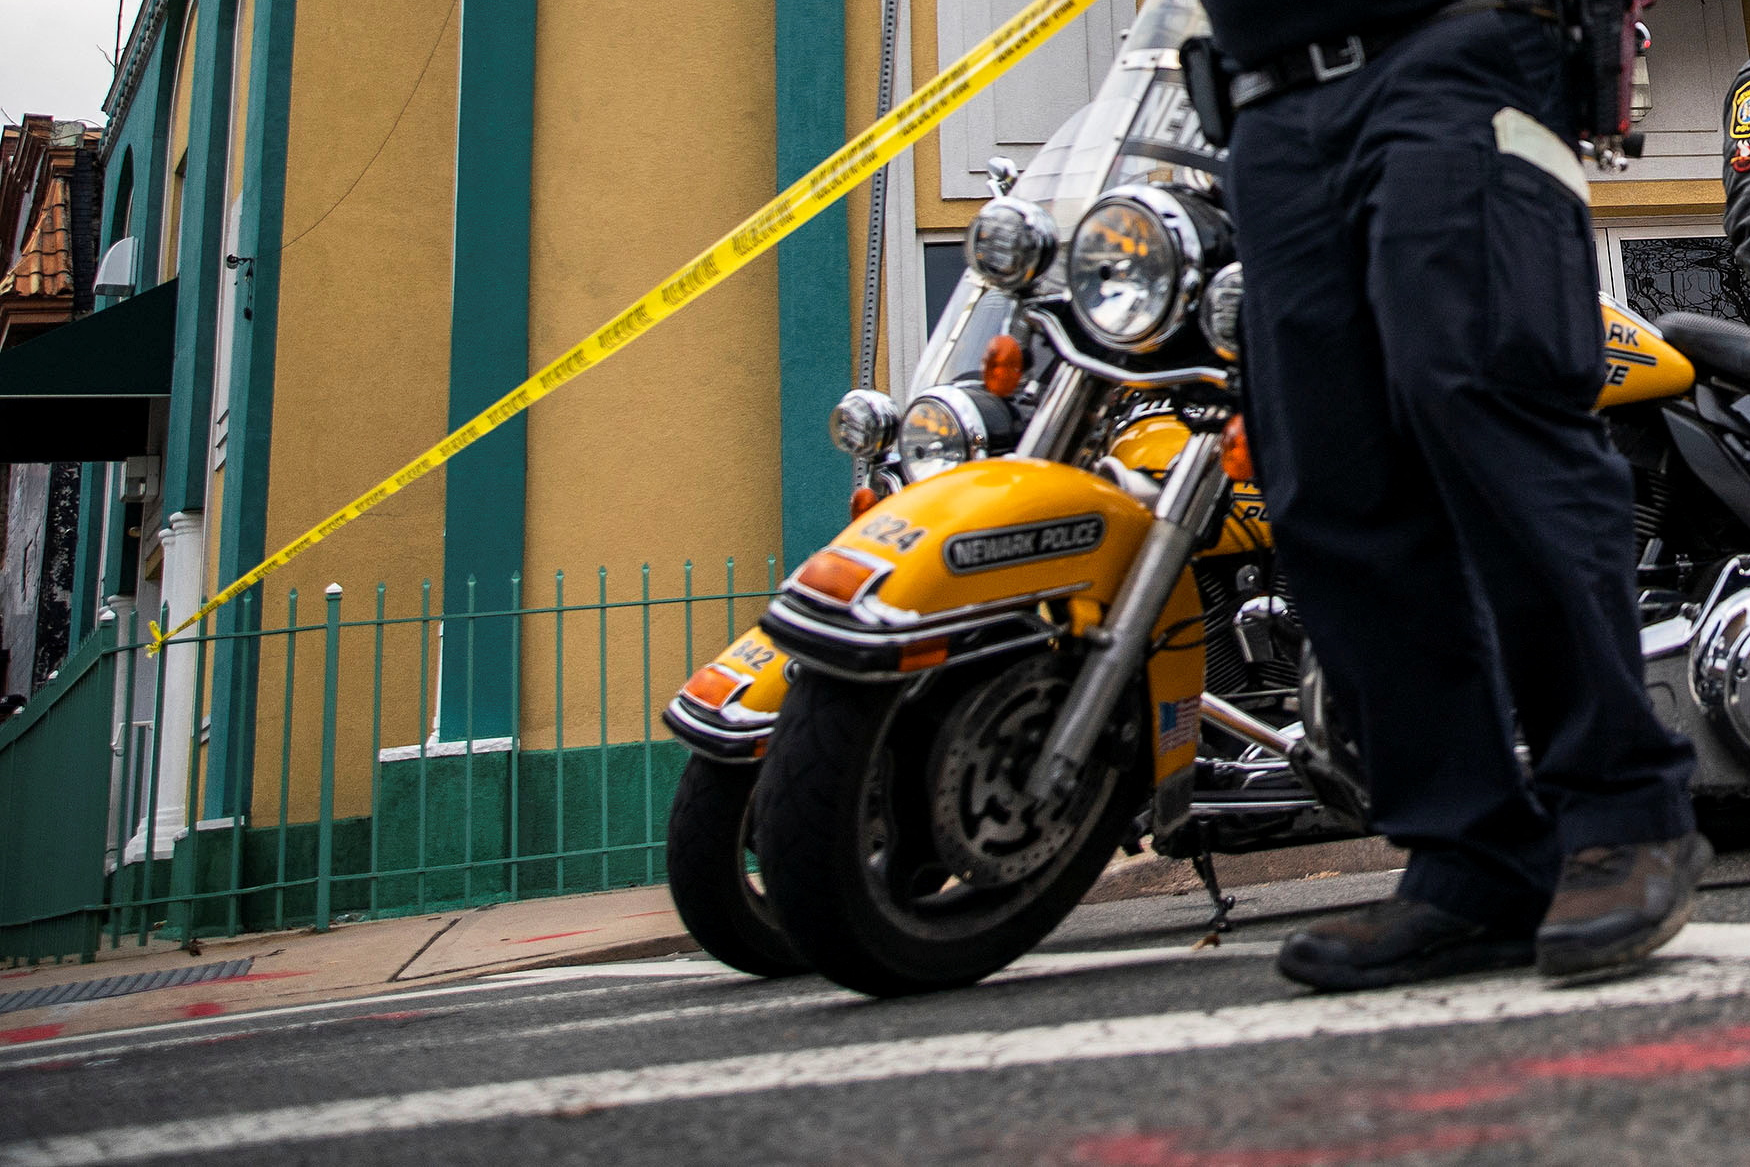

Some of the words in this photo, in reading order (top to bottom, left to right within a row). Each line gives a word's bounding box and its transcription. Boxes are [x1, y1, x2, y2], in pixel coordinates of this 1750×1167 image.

[954, 532, 1038, 565] NEWARK
[1038, 521, 1100, 552] POLICE
[731, 640, 776, 671] 842
